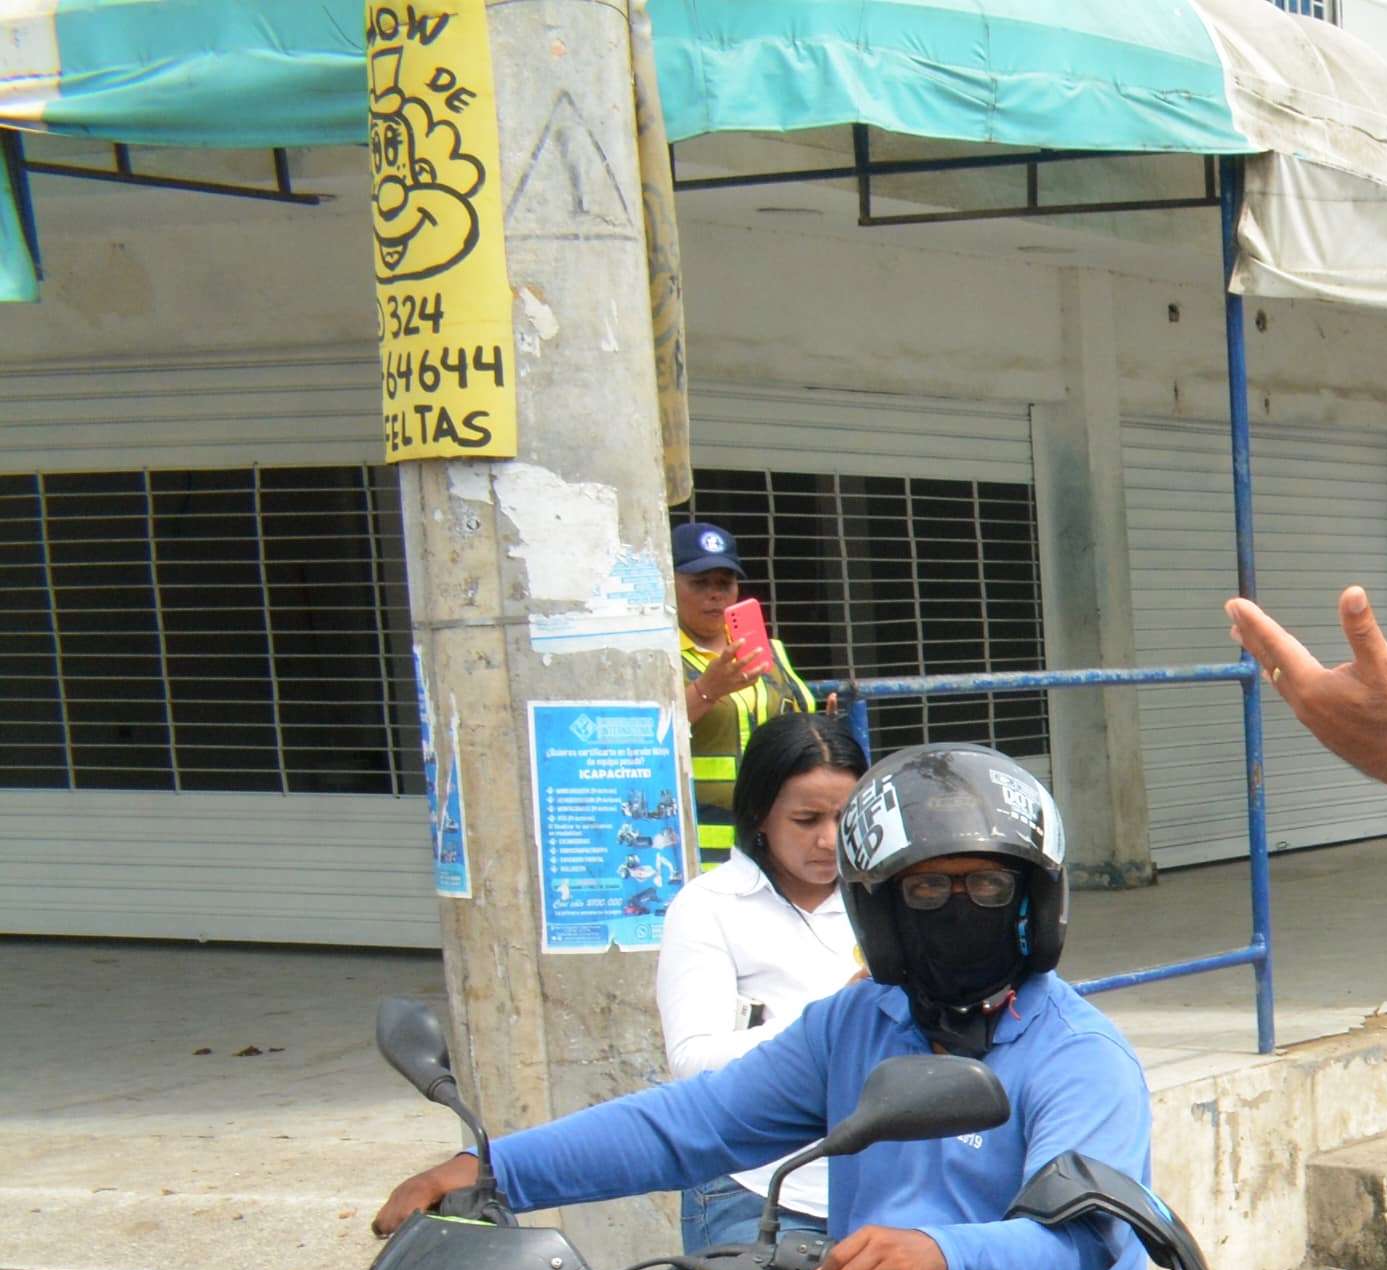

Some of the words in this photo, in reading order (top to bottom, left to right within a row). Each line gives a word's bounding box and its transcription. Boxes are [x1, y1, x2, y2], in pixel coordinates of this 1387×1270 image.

[425, 66, 477, 113] DE
[387, 292, 444, 339] 324
[382, 345, 504, 400] 64644
